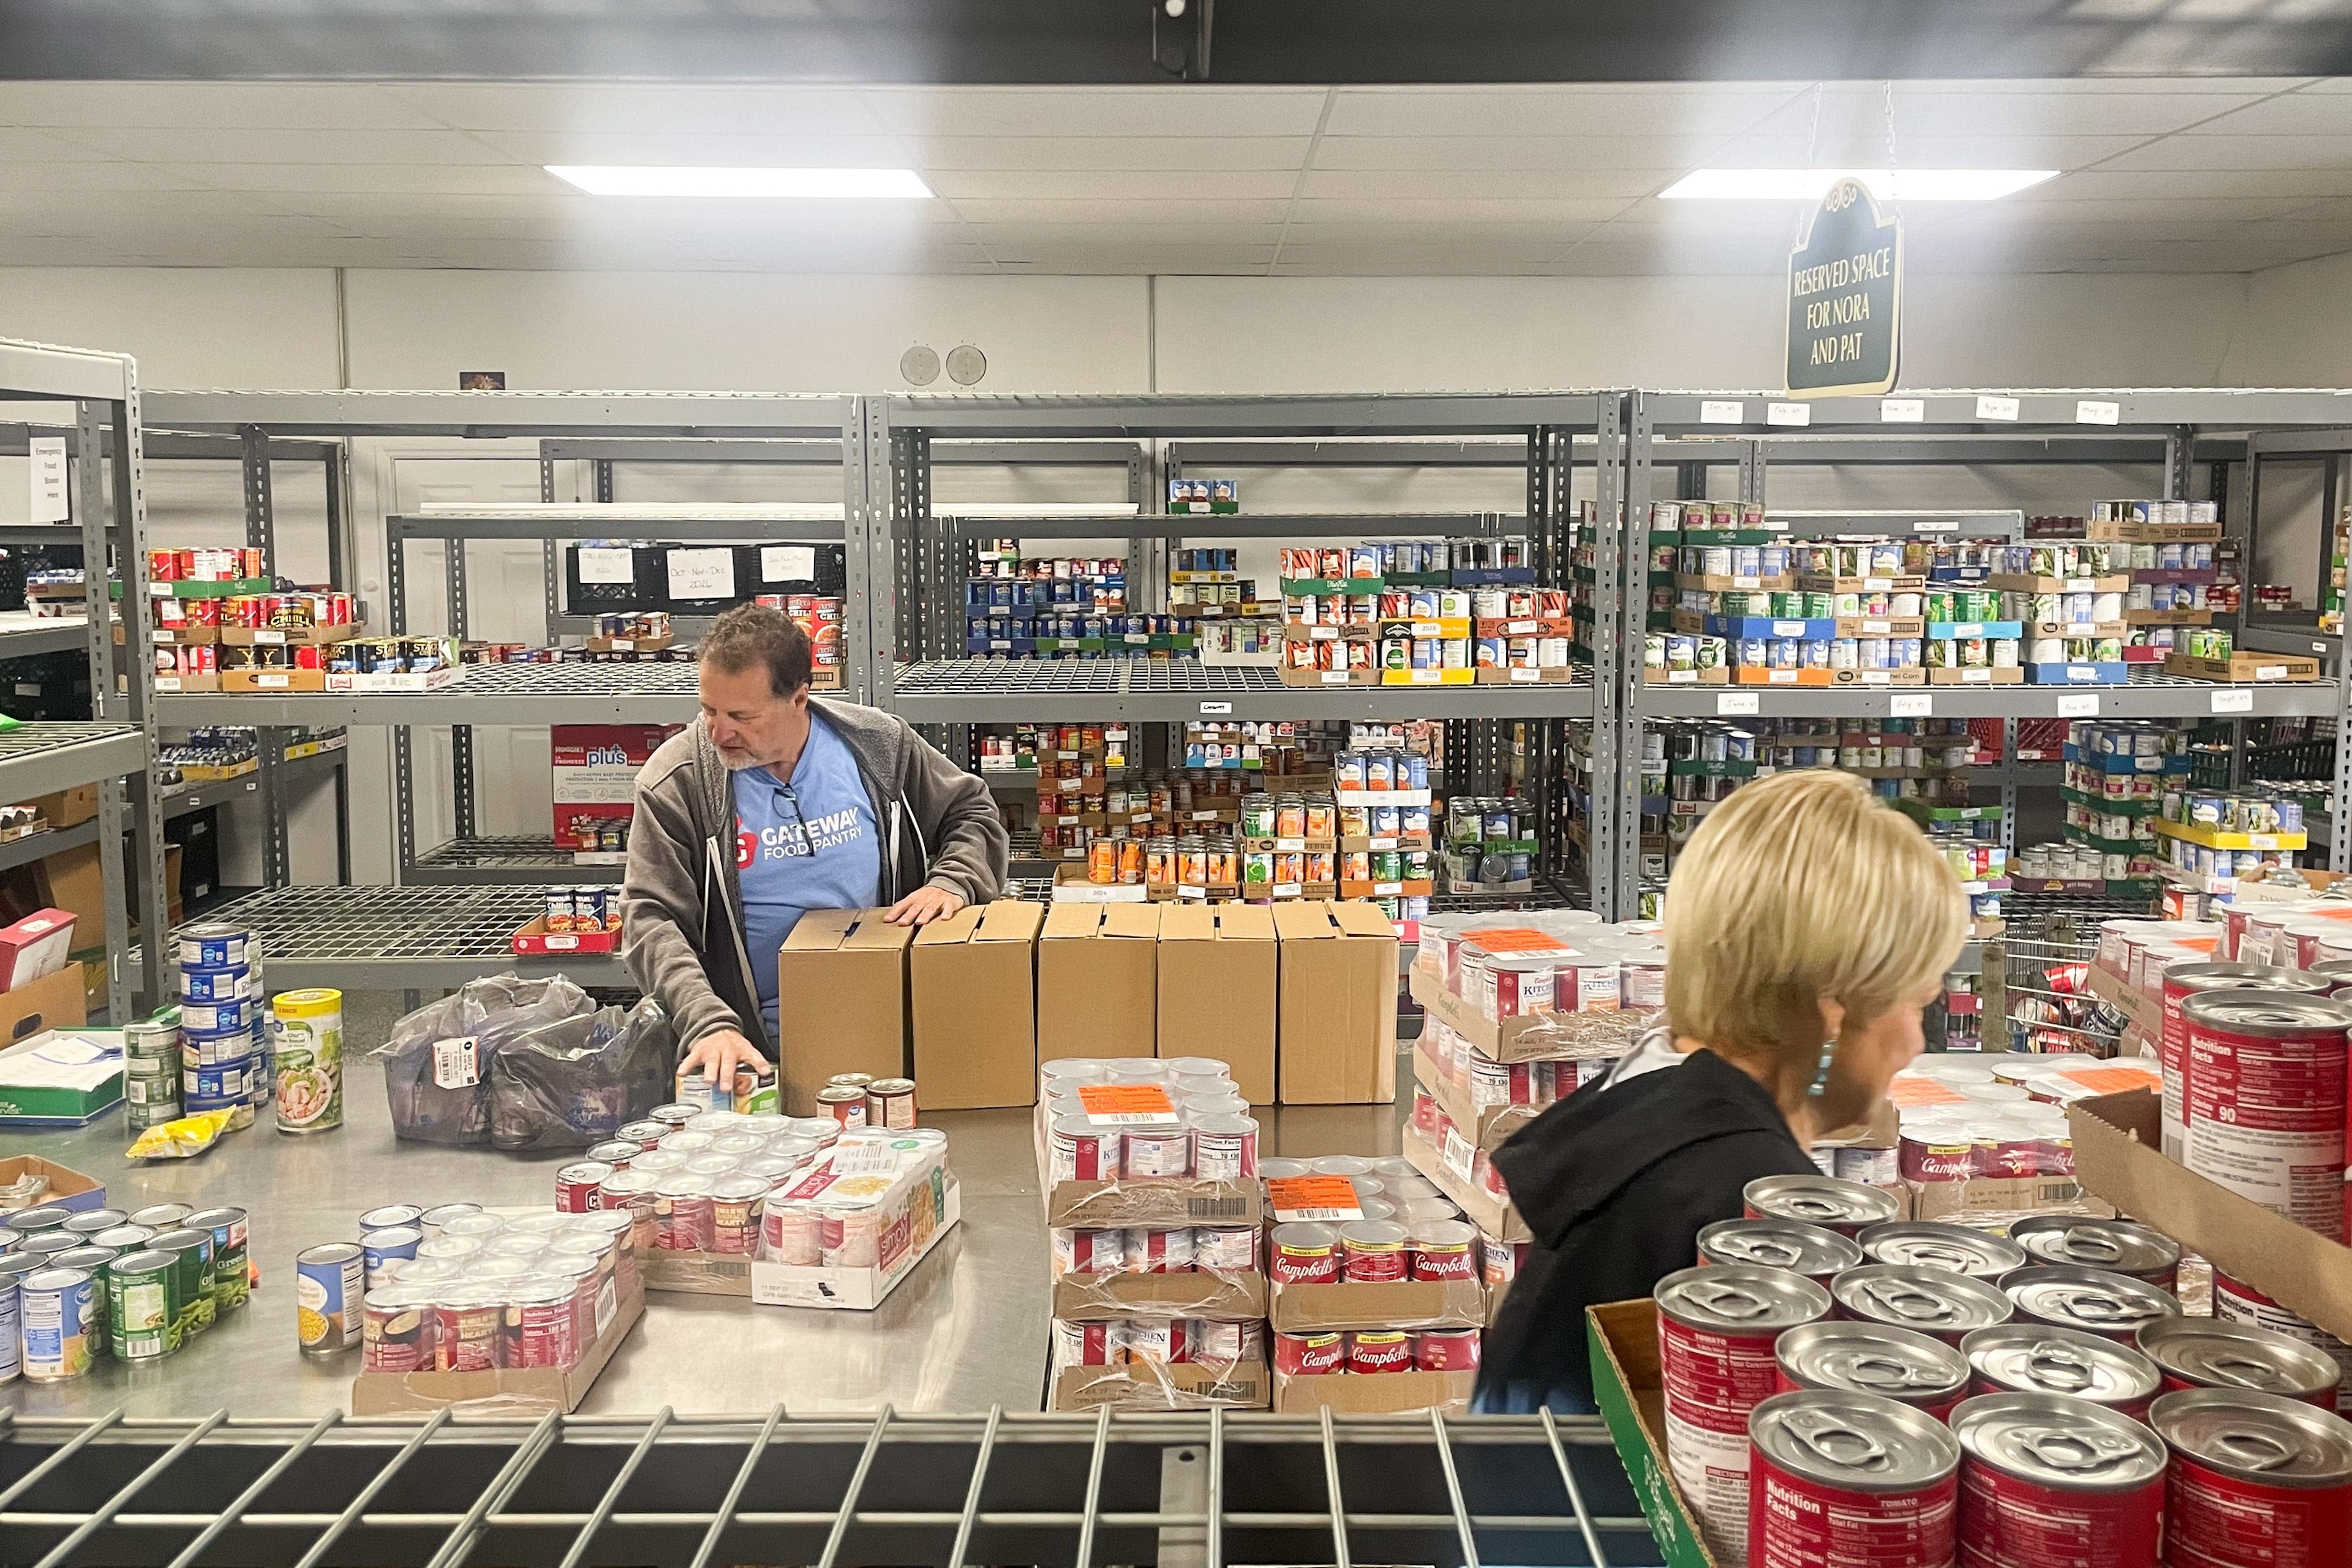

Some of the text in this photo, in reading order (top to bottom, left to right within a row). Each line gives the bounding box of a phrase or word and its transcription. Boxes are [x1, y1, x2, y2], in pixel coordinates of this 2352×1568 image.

[1794, 247, 1890, 296] RESERVED SPACE
[1806, 292, 1870, 331] FOR NORA
[1811, 332, 1863, 366] AND PAT
[589, 748, 626, 768] plus
[761, 807, 859, 846] GATEWAY
[764, 826, 862, 861] FOOD PANTRY
[2190, 1035, 2232, 1057] Nutrition
[2190, 1046, 2215, 1065] Facts
[2218, 1106, 2236, 1123] 90
[217, 1253, 245, 1270] Green
[1276, 1256, 1333, 1280] Campbell's
[2218, 1289, 2254, 1319] Nutrition
[1352, 1343, 1408, 1368] Campbell's
[1767, 1477, 1820, 1515] Nutrition
[1767, 1495, 1797, 1521] Facts
[1880, 1498, 1918, 1507] TOMATO
